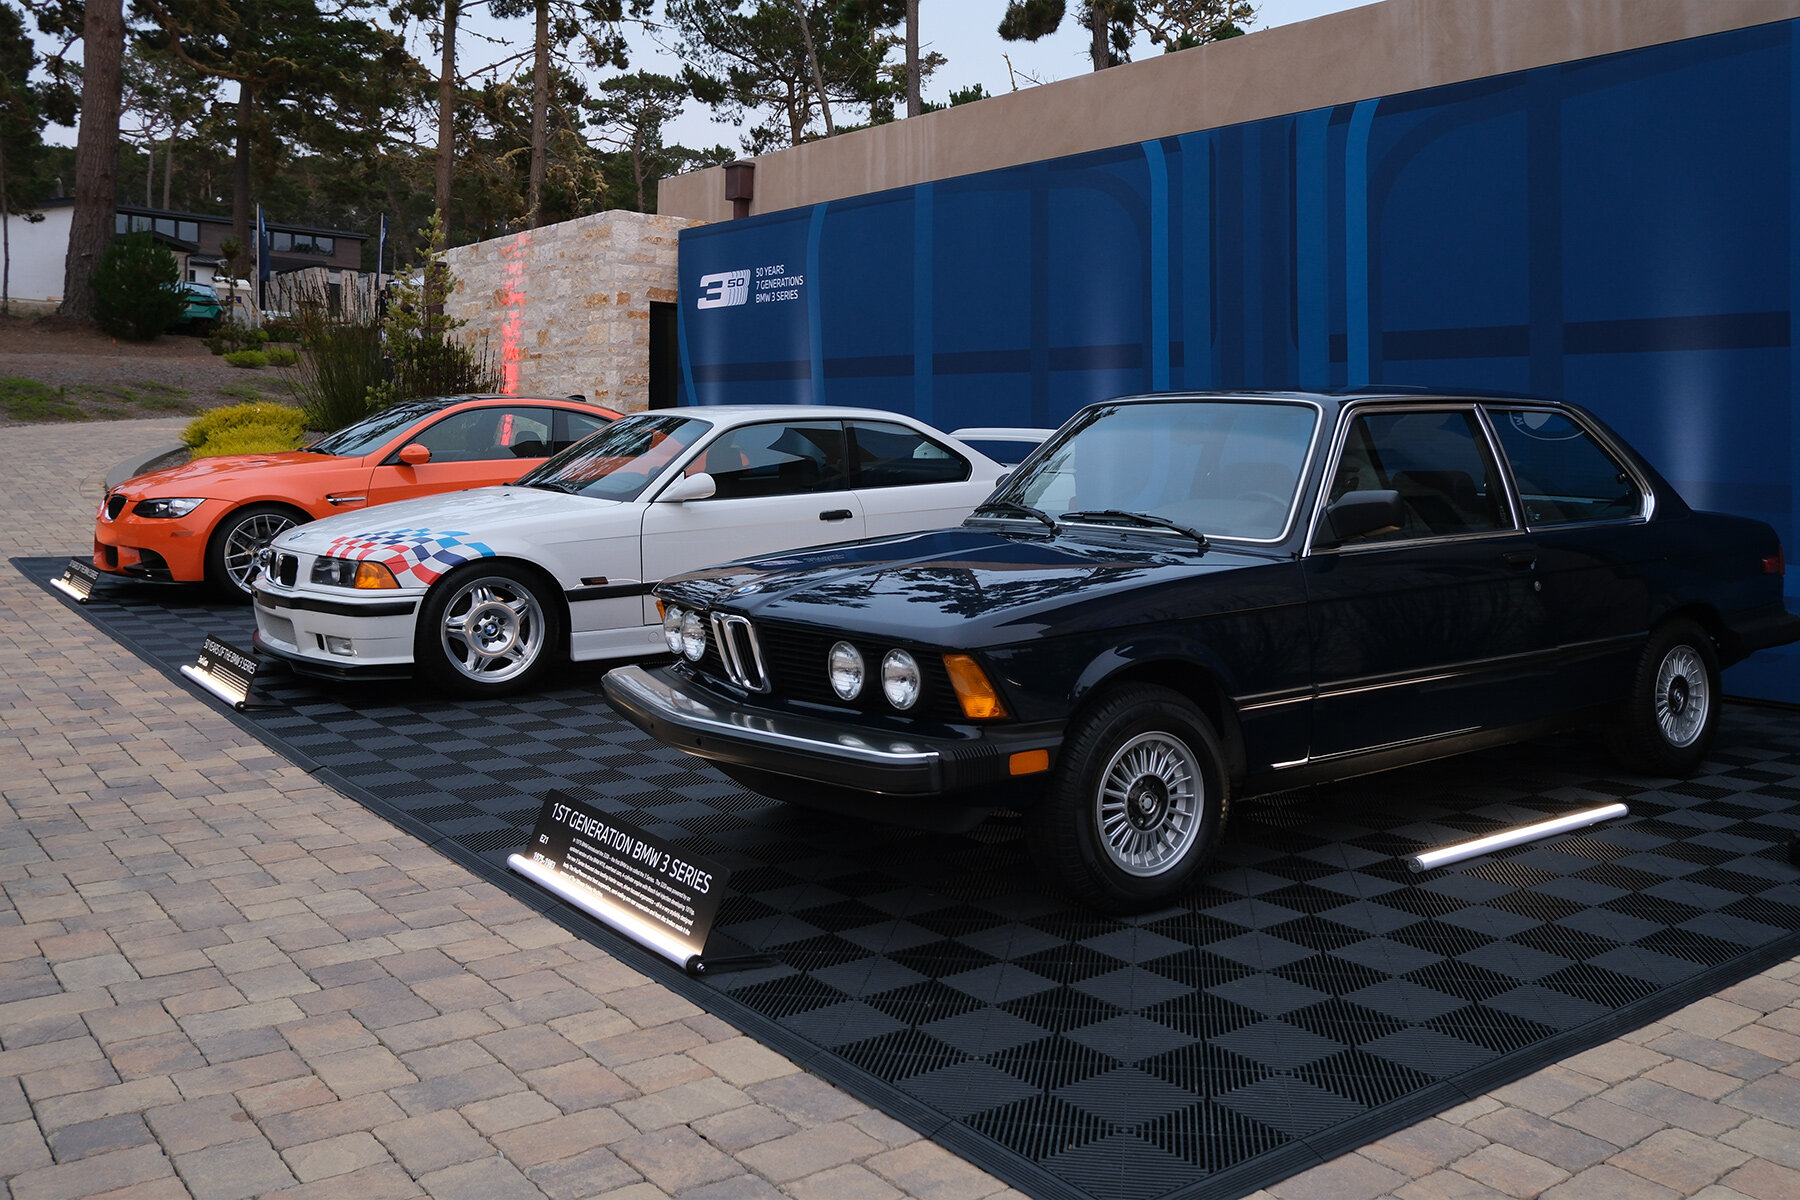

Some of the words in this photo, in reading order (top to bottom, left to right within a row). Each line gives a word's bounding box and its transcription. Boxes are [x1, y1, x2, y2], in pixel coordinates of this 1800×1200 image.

[756, 268, 764, 277] 50
[764, 264, 784, 276] YEARS
[727, 278, 744, 288] 50
[756, 281, 761, 290] 7
[761, 275, 804, 290] GENERATIONS
[756, 292, 771, 303] BMW
[771, 292, 776, 302] 3
[776, 290, 798, 301] SERIES
[539, 834, 549, 845] E21
[552, 802, 571, 824] 1ST
[569, 810, 634, 854] GENERATION
[632, 840, 662, 868] BMW
[659, 854, 670, 873] 3
[668, 858, 713, 894] SERIES
